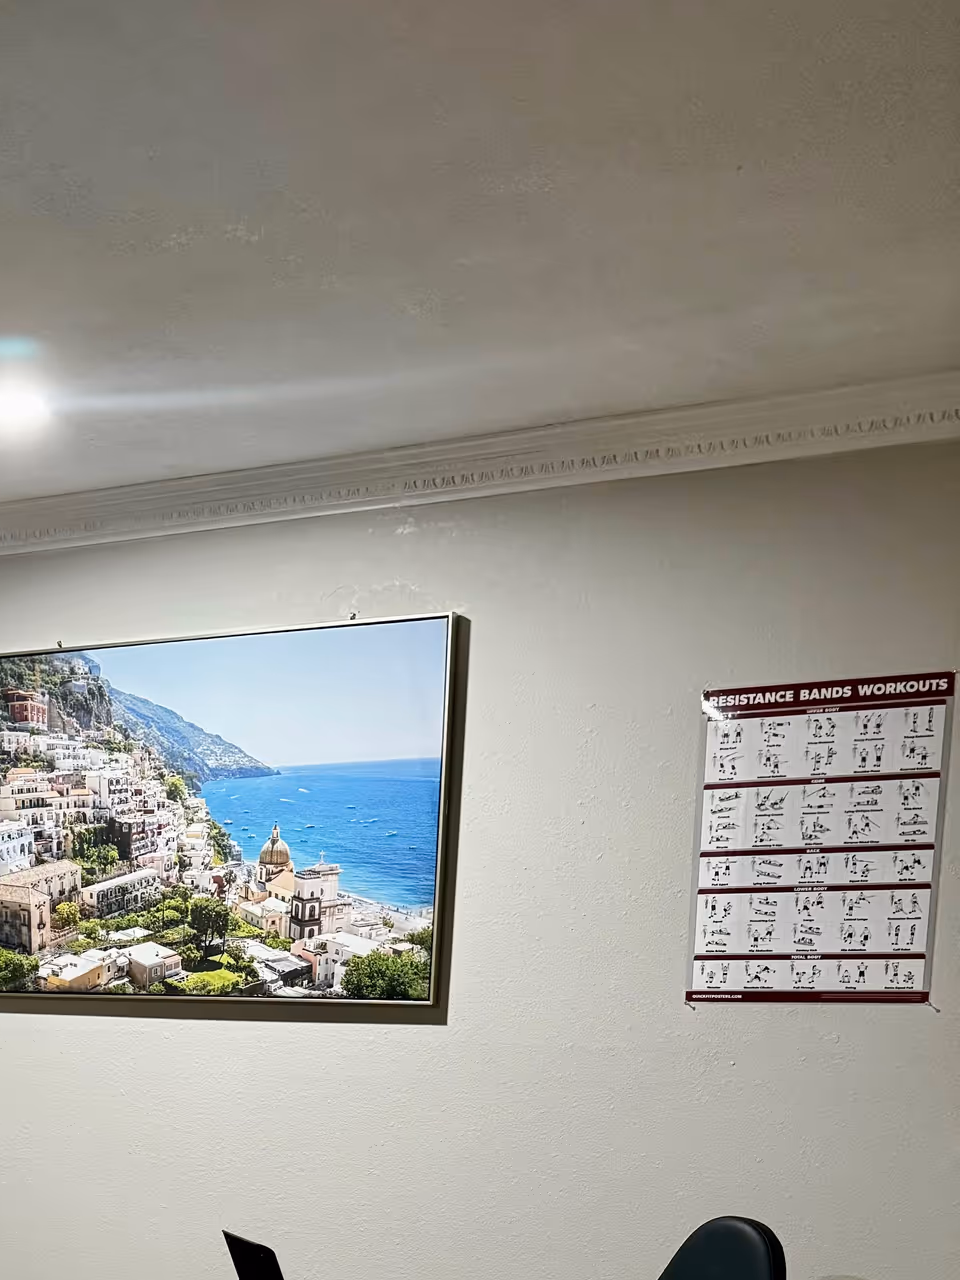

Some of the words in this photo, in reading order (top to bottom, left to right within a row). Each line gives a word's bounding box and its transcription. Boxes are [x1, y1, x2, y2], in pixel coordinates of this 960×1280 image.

[708, 689, 794, 706] RESISTANCE
[799, 684, 852, 700] BANDS
[858, 678, 948, 696] WORKOUTS
